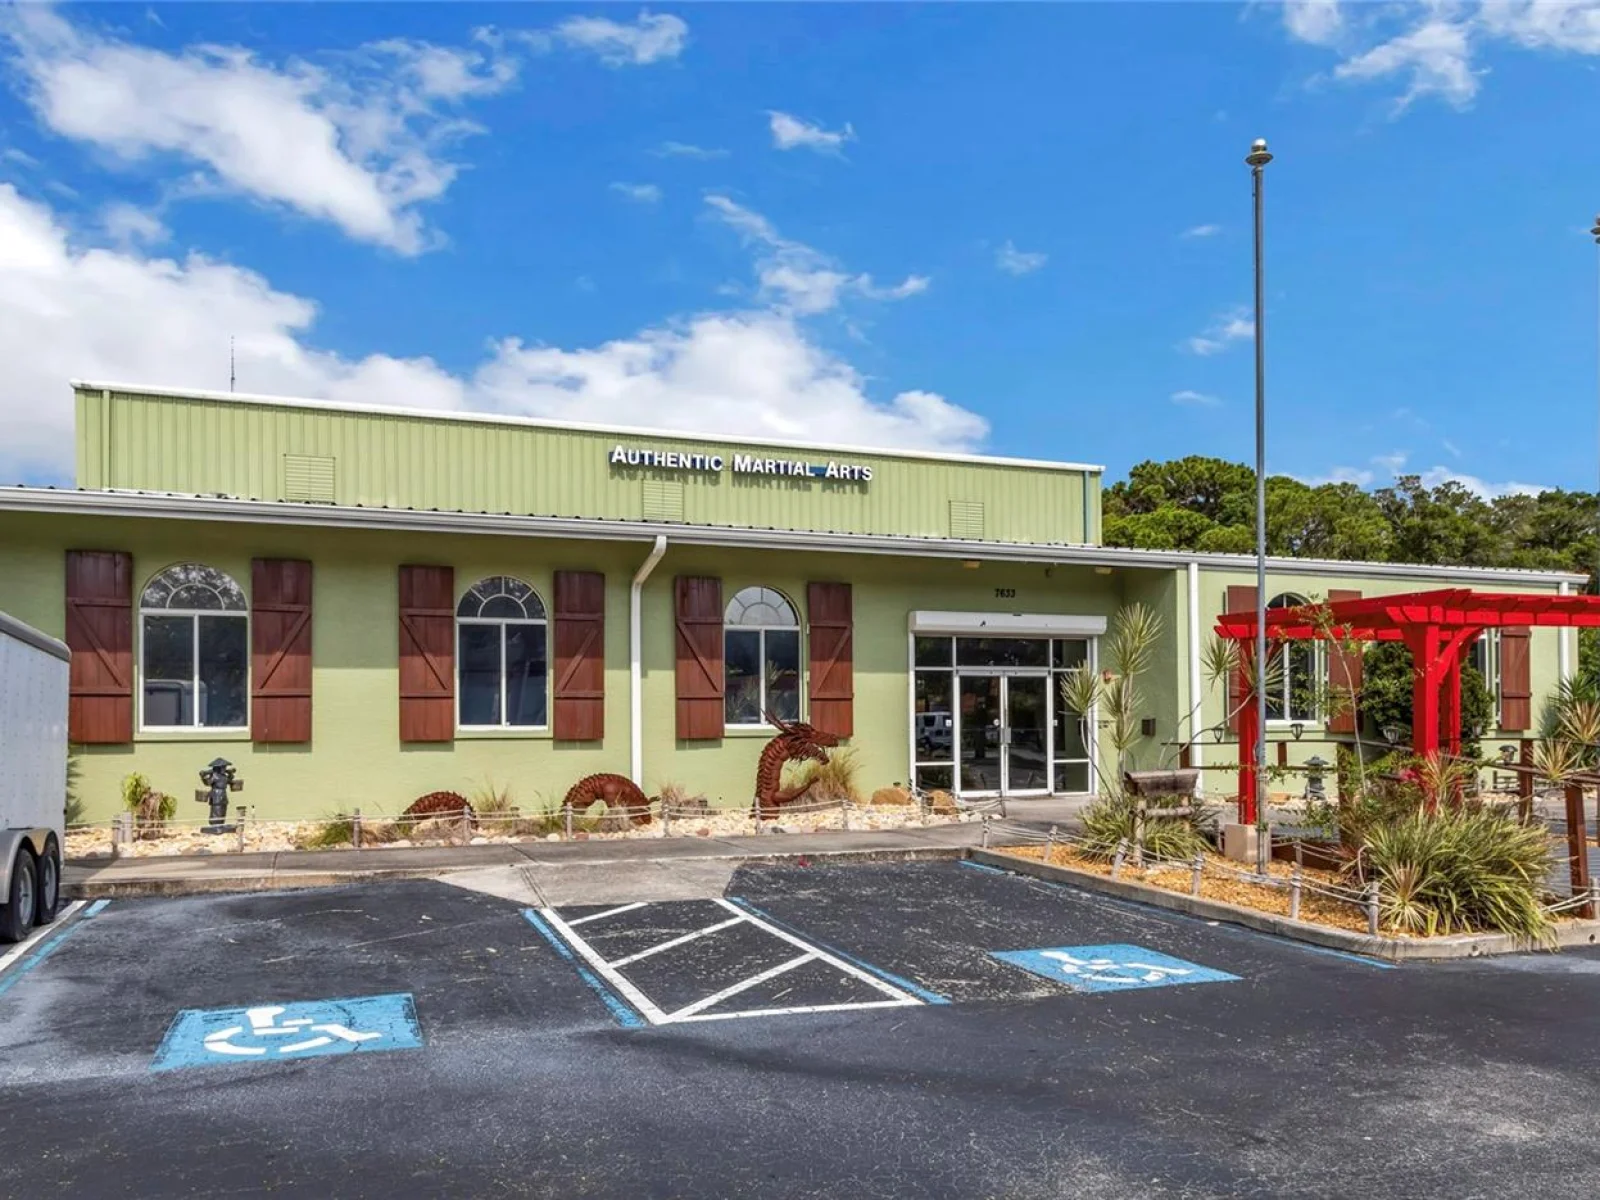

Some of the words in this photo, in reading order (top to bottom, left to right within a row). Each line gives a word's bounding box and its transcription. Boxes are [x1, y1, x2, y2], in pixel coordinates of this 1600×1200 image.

[611, 445, 723, 471] AUTHENTIC
[733, 454, 815, 477] MARTIAL
[825, 461, 873, 481] ARTS
[994, 588, 1016, 598] 7633
